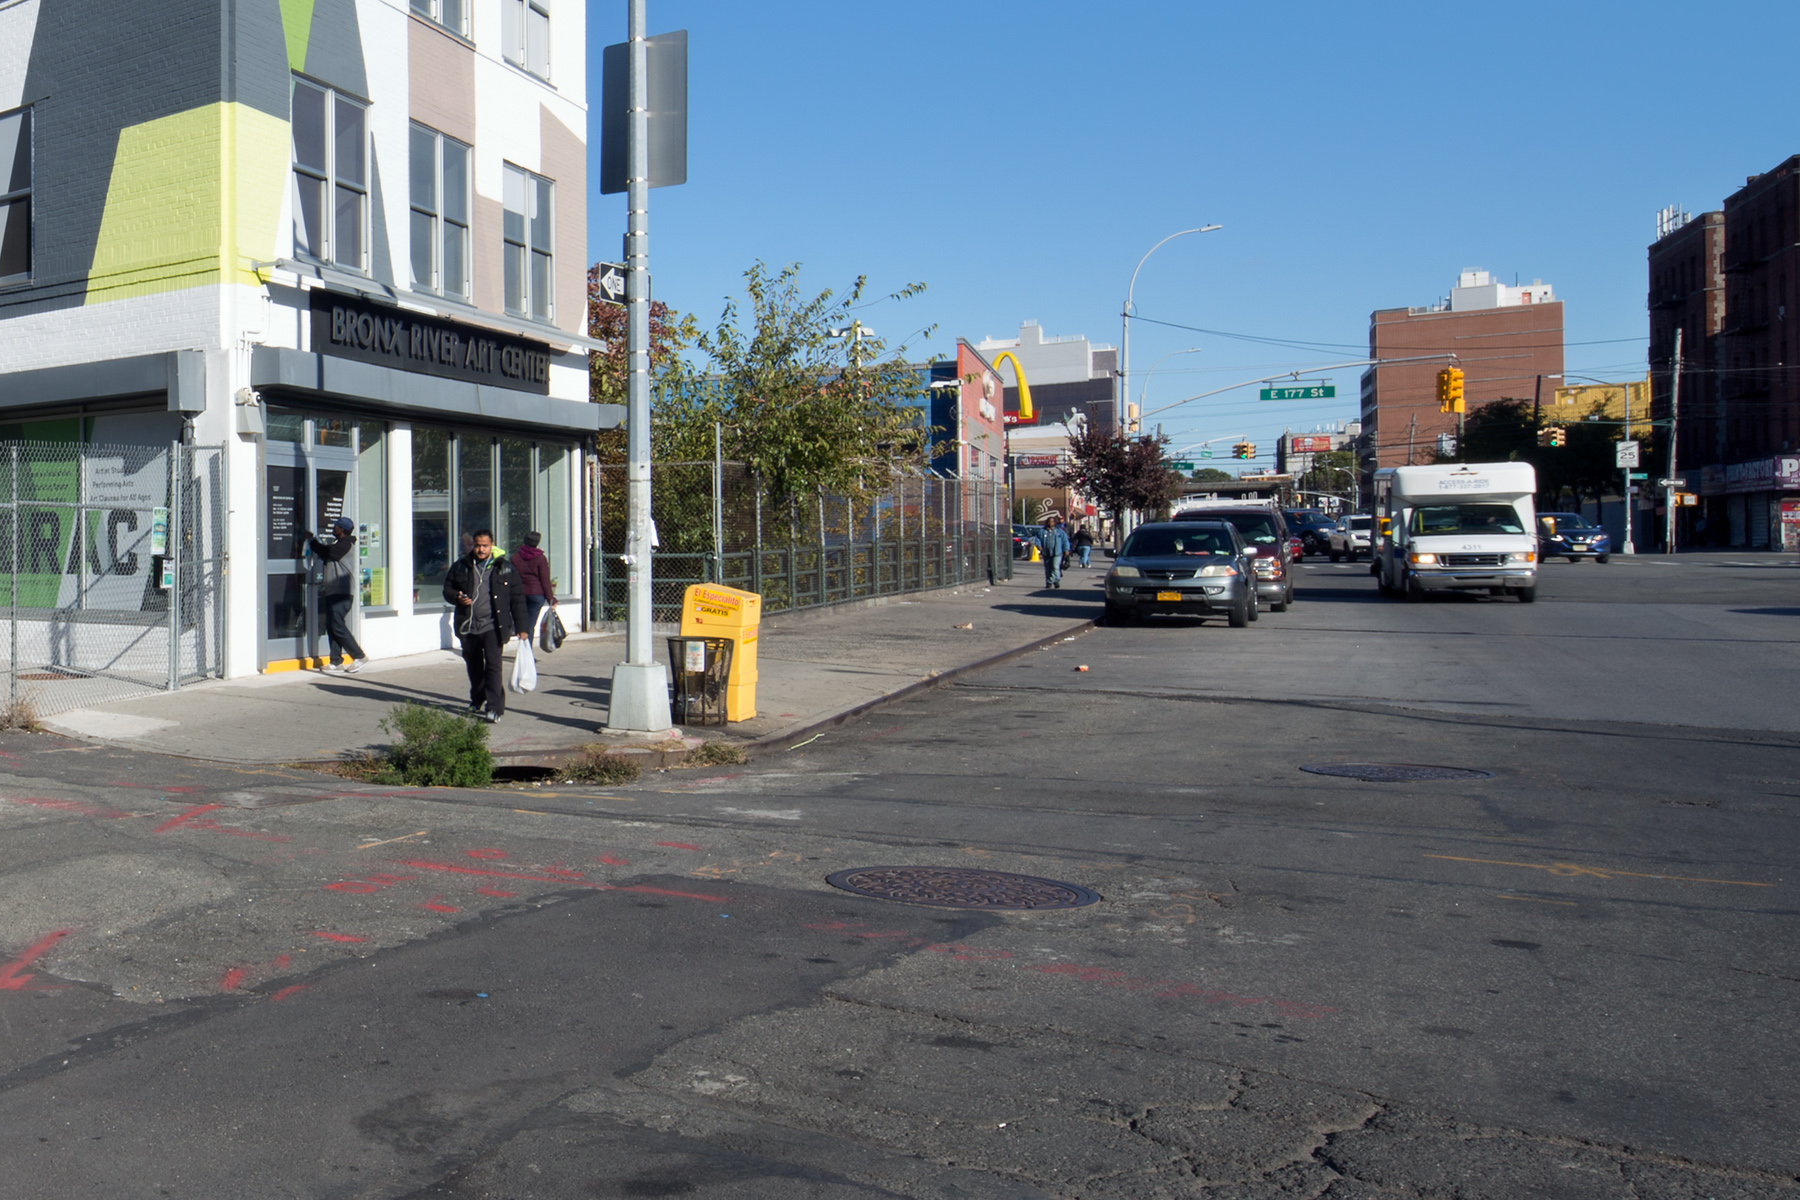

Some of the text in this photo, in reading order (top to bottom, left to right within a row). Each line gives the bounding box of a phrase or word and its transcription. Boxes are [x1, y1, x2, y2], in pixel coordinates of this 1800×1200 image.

[608, 276, 621, 292] ONE
[332, 306, 551, 383] BRONX RIVER ART CENTER
[1270, 388, 1324, 399] E 177 St
[1620, 451, 1636, 460] 25
[694, 587, 702, 597] El
[702, 589, 739, 606] Especialito
[701, 606, 729, 616] GRATIS
